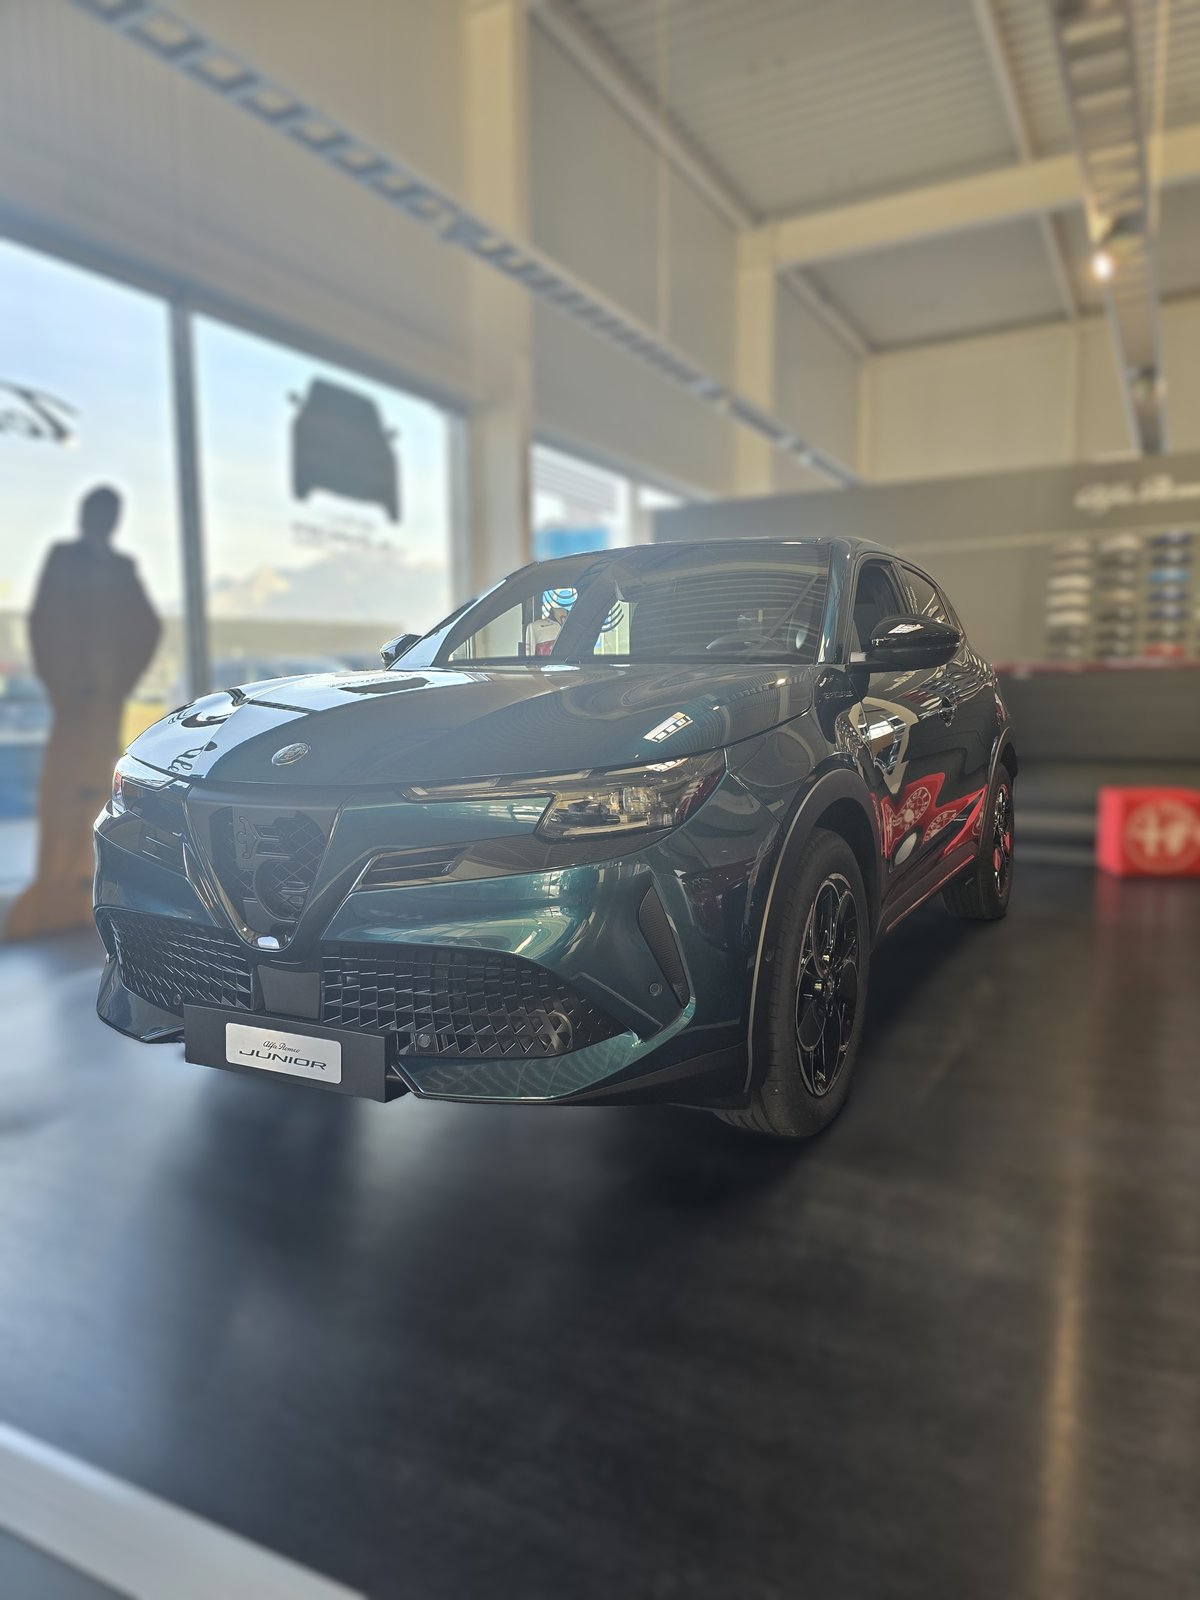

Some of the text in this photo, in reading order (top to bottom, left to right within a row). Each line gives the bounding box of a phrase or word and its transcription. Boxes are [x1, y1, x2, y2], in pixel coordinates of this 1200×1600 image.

[263, 1040, 301, 1054] Alfa Romeo
[239, 1049, 327, 1071] JUNIOR
